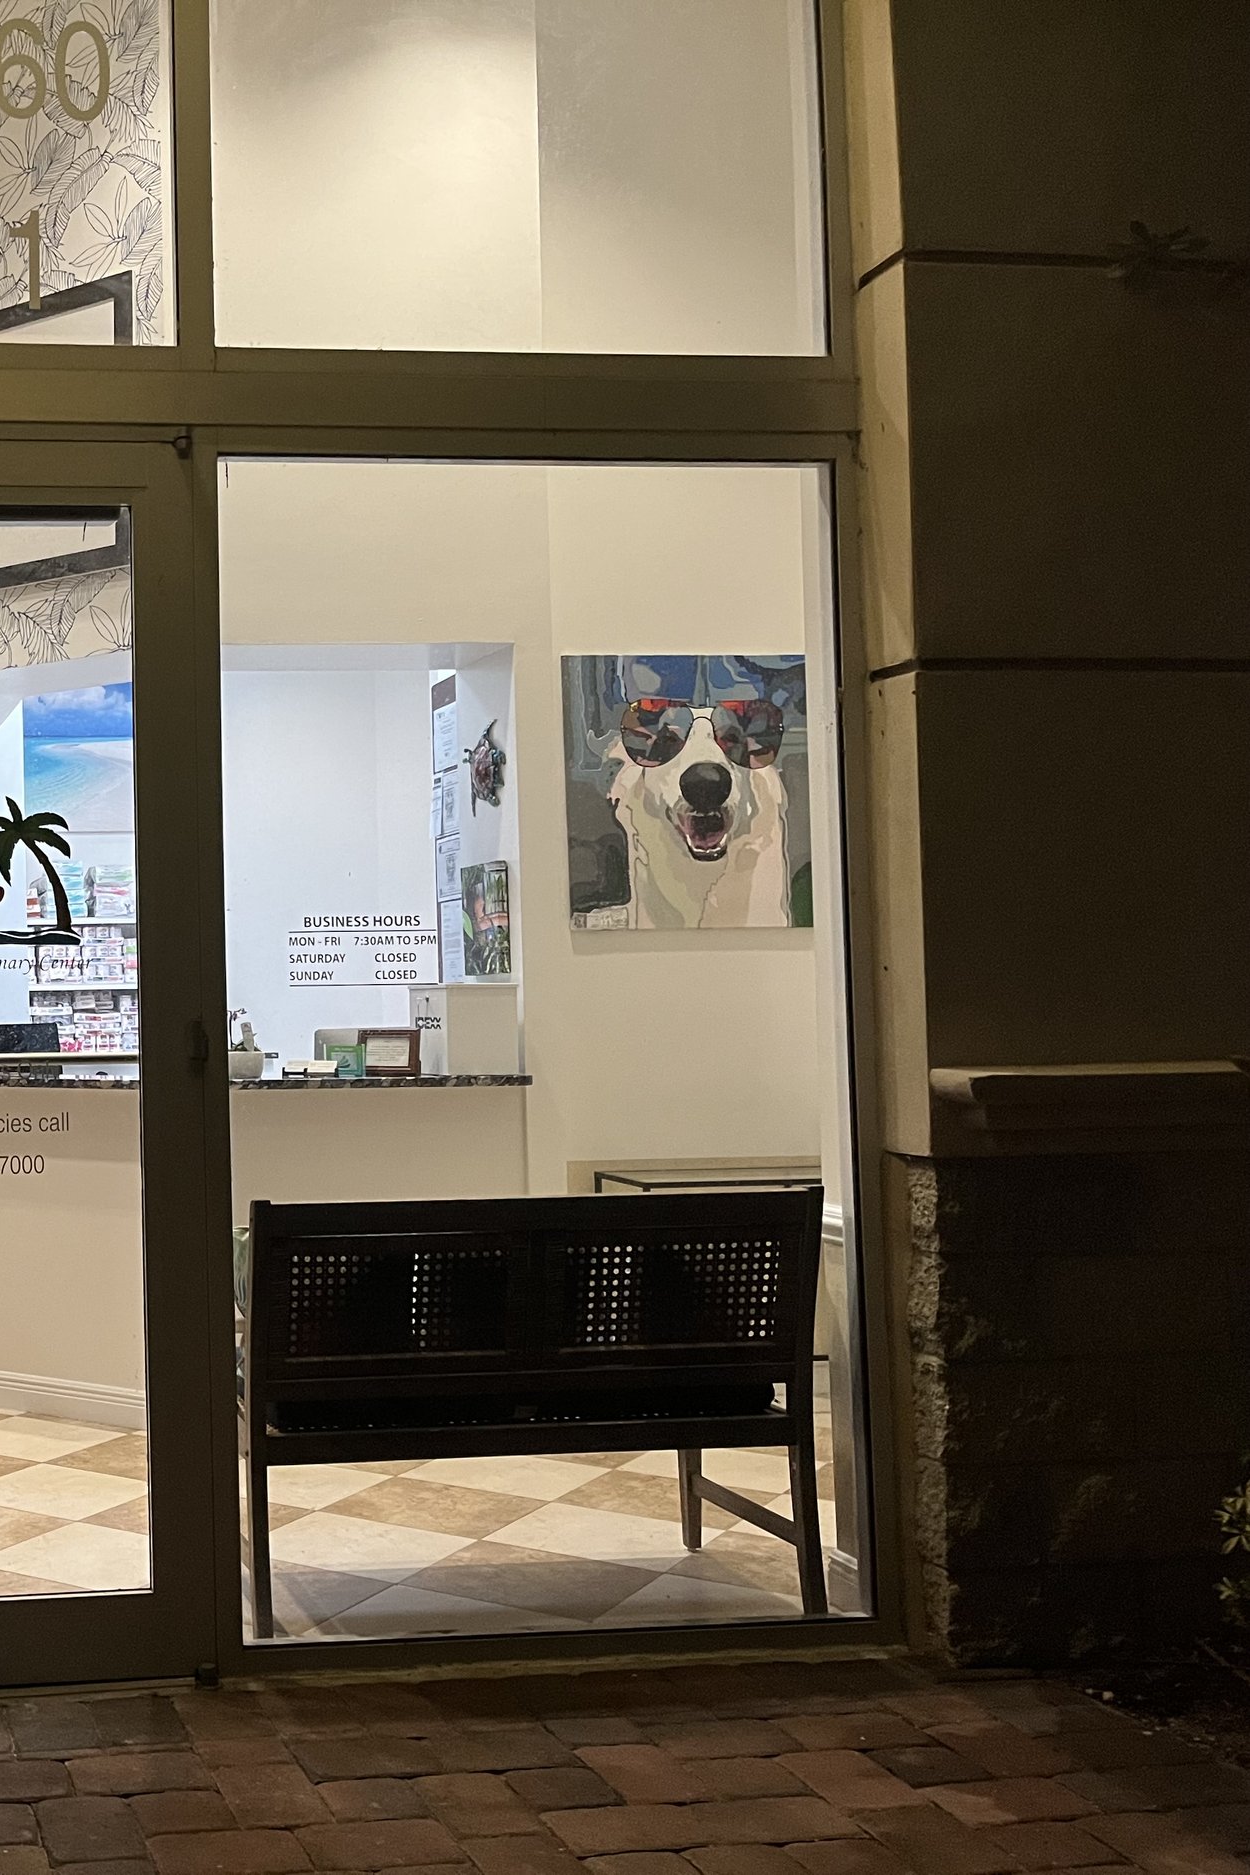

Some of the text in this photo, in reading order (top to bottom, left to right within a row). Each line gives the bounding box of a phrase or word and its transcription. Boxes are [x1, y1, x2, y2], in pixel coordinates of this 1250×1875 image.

[303, 915, 421, 927] BUSINESS HOURS
[289, 936, 315, 946] MON
[324, 936, 341, 946] FRI
[353, 935, 394, 946] 7:30AM
[396, 935, 411, 945] TO
[414, 935, 437, 945] 5PM
[40, 954, 94, 971] Center
[289, 952, 417, 964] SATURDAY CLOSED
[289, 970, 417, 981] SUNDAY CLOSED
[39, 1112, 70, 1132] call
